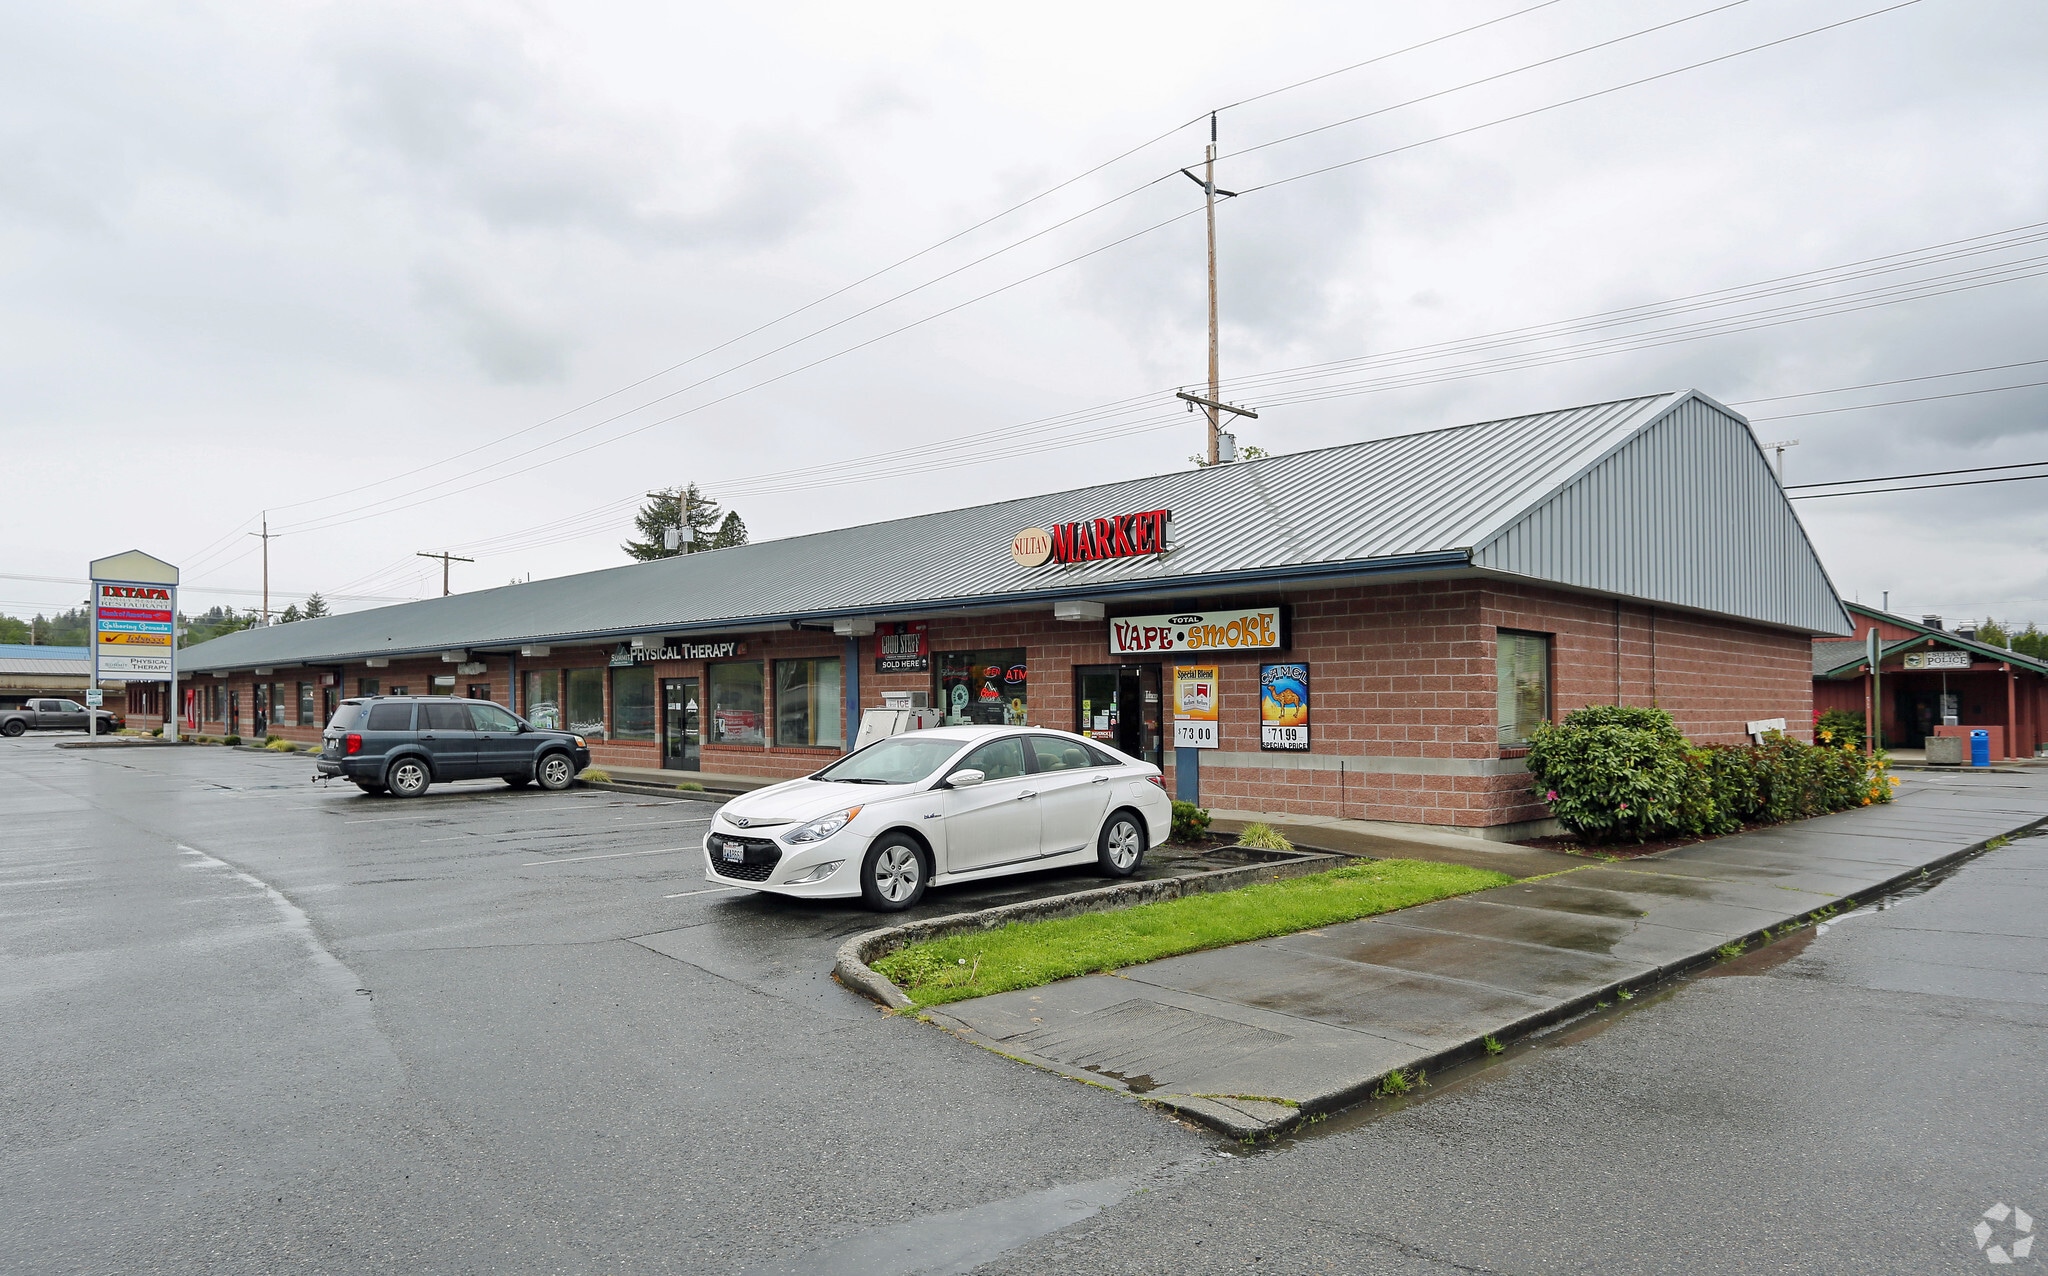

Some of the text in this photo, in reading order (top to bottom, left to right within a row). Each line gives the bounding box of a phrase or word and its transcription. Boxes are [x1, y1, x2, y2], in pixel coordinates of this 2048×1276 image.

[1053, 509, 1167, 564] MARKET
[1014, 536, 1048, 556] SULTAN
[102, 586, 170, 600] IXTAPA
[101, 601, 169, 609] RESTAURANT
[1171, 616, 1200, 624] TOTAL
[102, 621, 168, 632] Gathering Grounds
[1114, 613, 1276, 652] VAPE SMOKE
[630, 646, 681, 661] PHYSICAL
[682, 643, 735, 659] THERAPY
[901, 660, 920, 668] HERE
[1927, 657, 1967, 665] POLICE
[1005, 669, 1028, 680] ATM
[1177, 669, 1213, 680] Special Blend
[1261, 665, 1308, 686] CAMEL
[897, 700, 909, 708] ICE
[1262, 741, 1287, 749] SPECIAL
